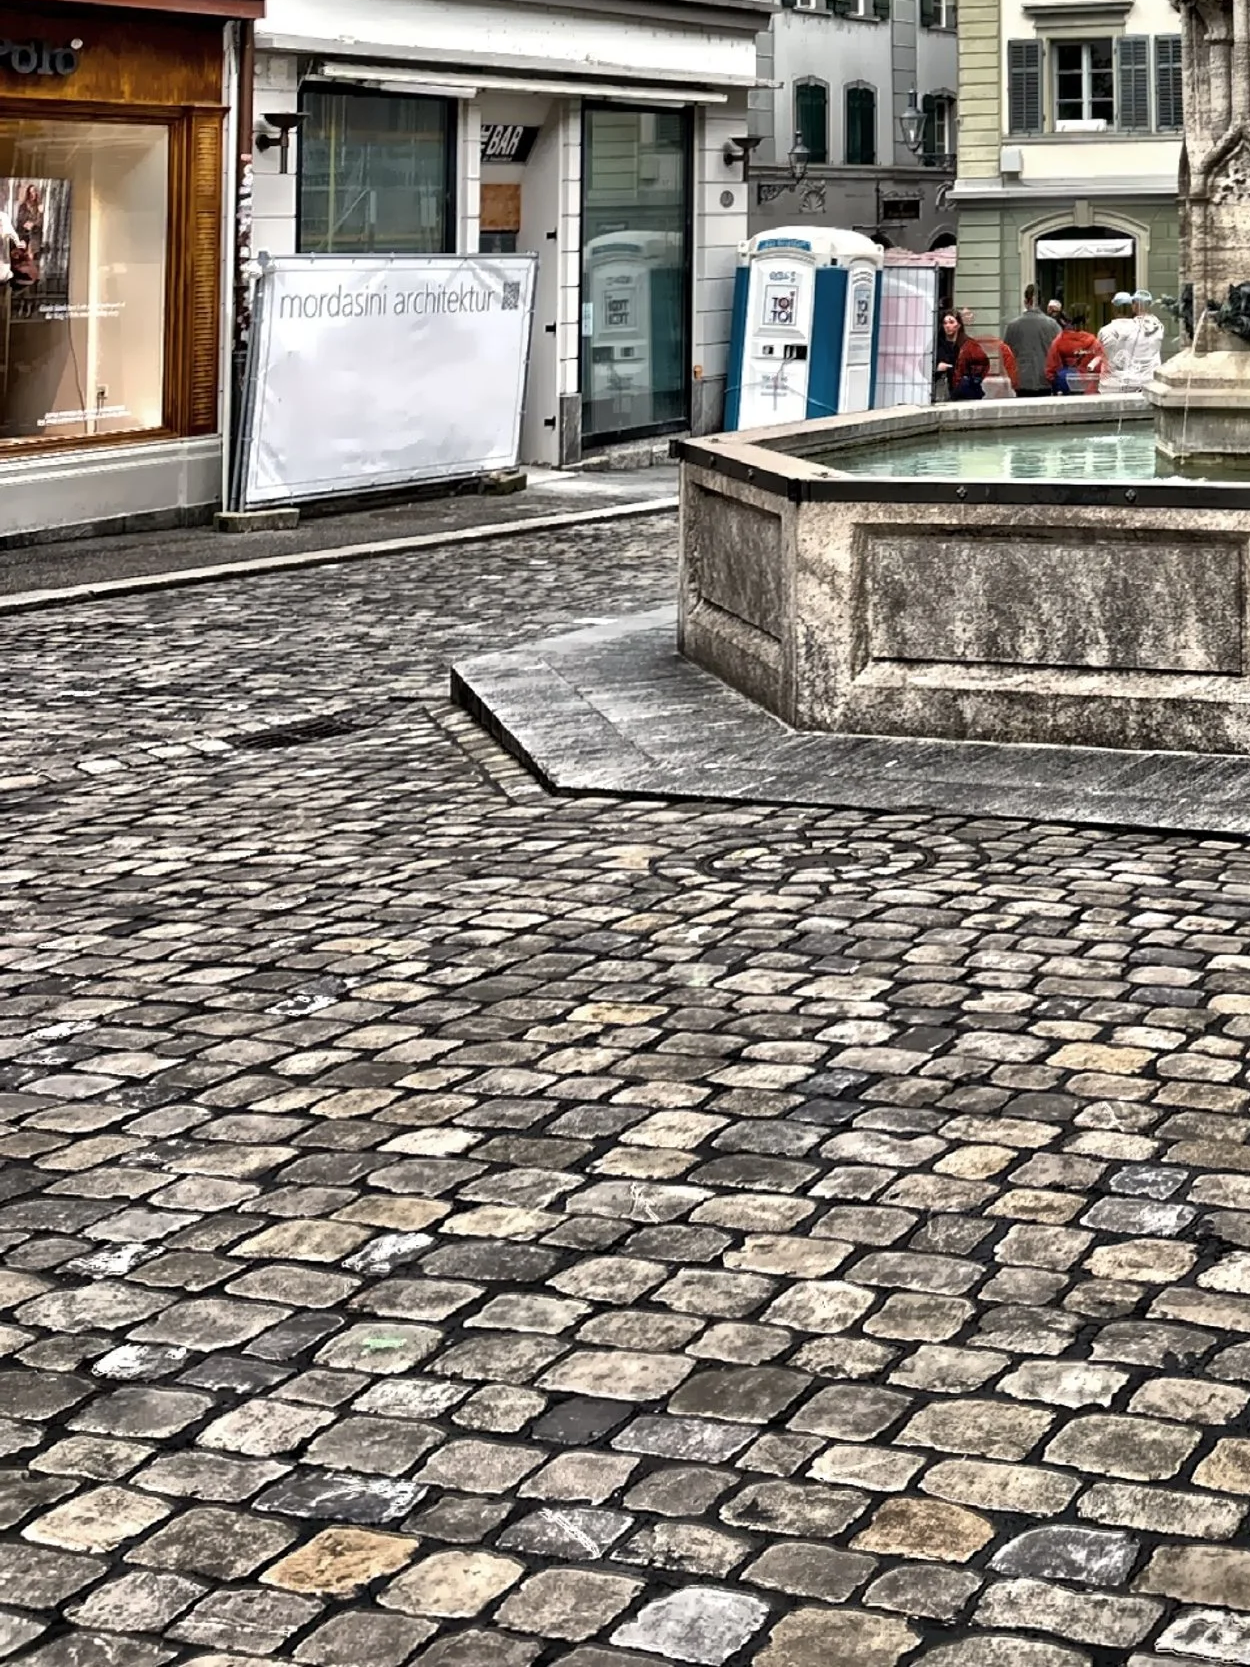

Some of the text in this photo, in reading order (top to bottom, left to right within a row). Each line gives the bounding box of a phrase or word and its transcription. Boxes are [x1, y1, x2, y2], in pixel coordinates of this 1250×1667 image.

[486, 125, 524, 155] BAR
[279, 283, 495, 319] mordasini architektur
